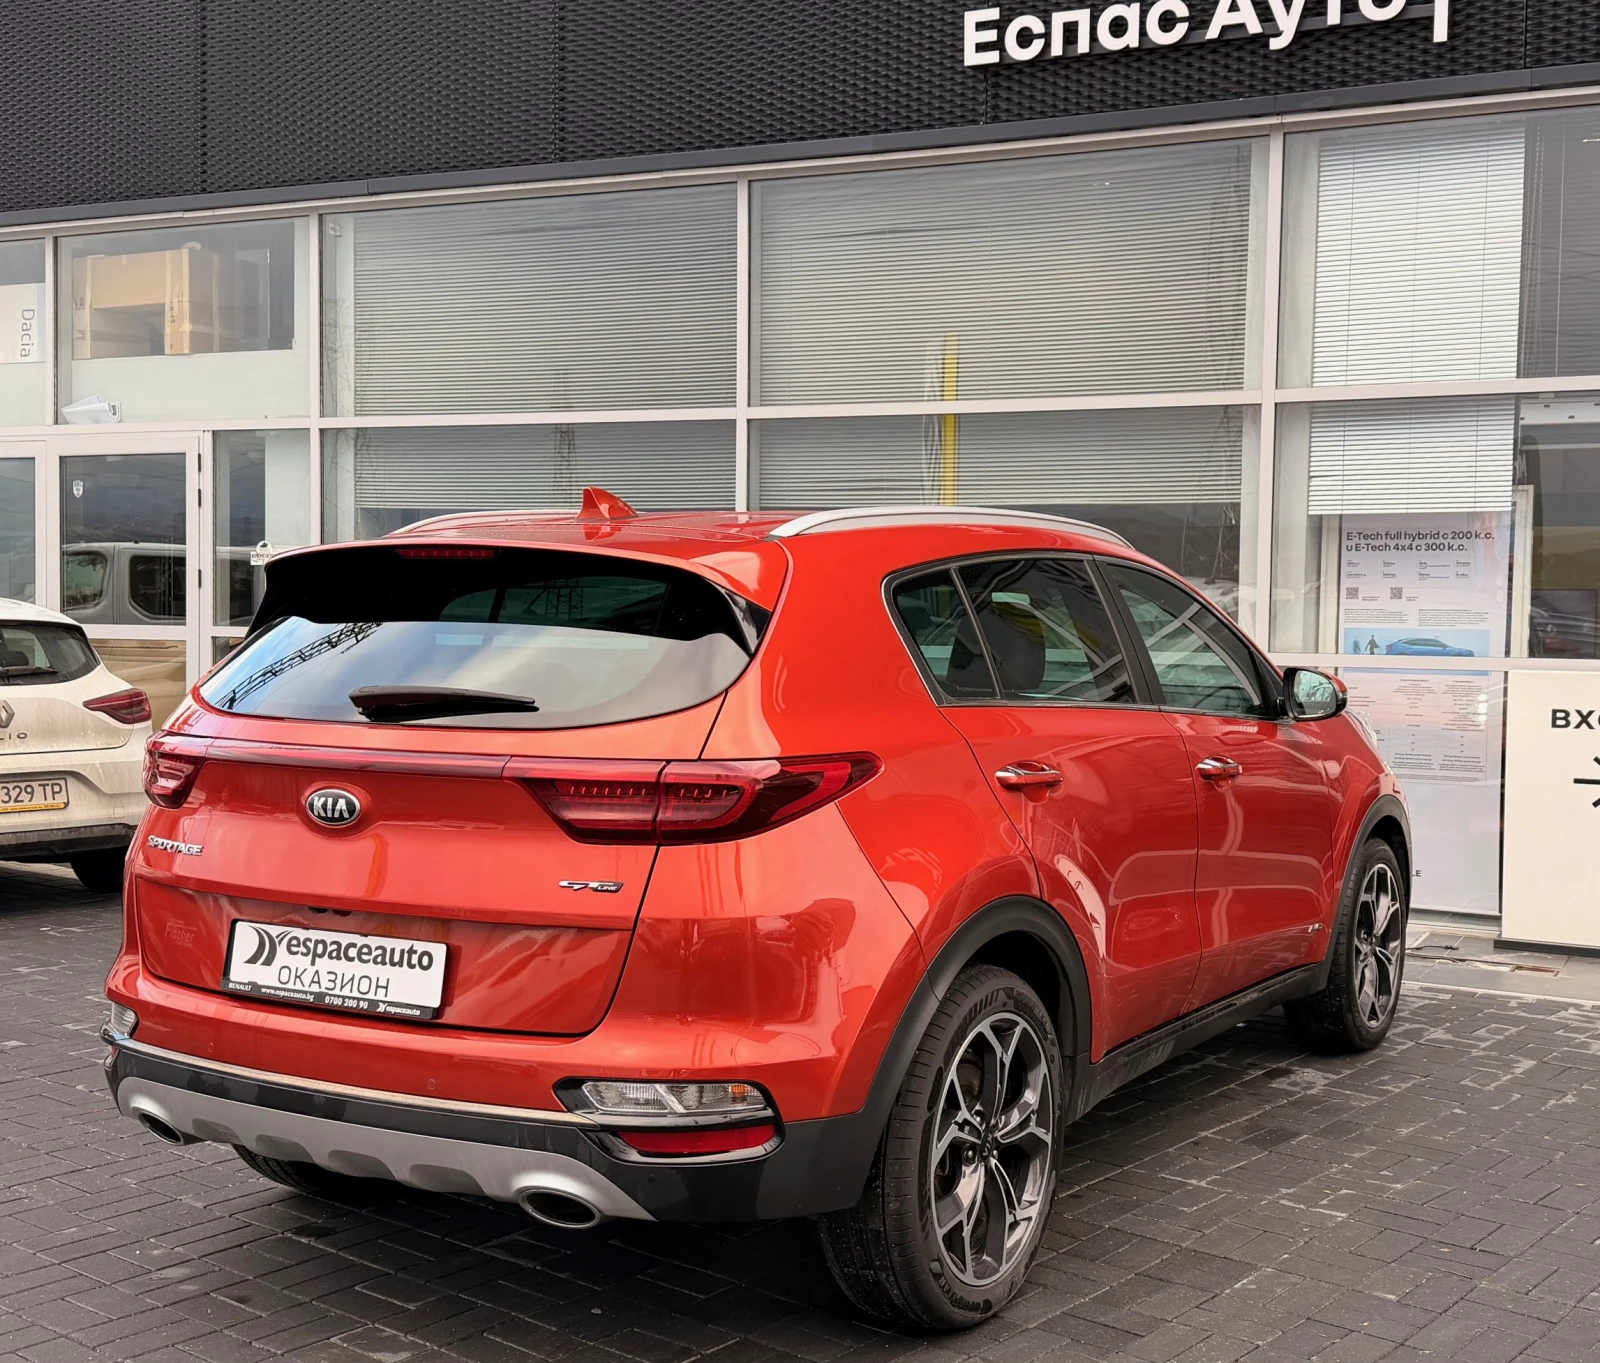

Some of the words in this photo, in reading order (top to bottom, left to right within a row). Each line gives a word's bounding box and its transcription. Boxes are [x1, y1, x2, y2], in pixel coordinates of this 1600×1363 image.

[963, 0, 1190, 66] Еспас
[20, 308, 35, 359] Dacia
[1346, 531, 1383, 541] E-Tech
[1385, 530, 1402, 541] full
[1404, 530, 1440, 542] hybrid
[1450, 530, 1472, 540] 200
[1355, 542, 1391, 552] E-Tech
[1393, 542, 1413, 552] 4x4
[1424, 542, 1446, 552] 300
[1551, 708, 1600, 730] ВХ
[313, 795, 349, 821] KIA
[147, 835, 203, 856] SPORTAGE
[165, 922, 196, 943] Fischer
[286, 936, 434, 973] espaceauto
[277, 965, 390, 998] ОКАЗИОН
[228, 982, 253, 992] RENAULT
[261, 986, 315, 1002] www.espaceauto.bg
[324, 995, 343, 1006] 0700
[343, 998, 357, 1008] 200
[359, 1000, 369, 1010] 90
[386, 1005, 421, 1016] espaceauto
